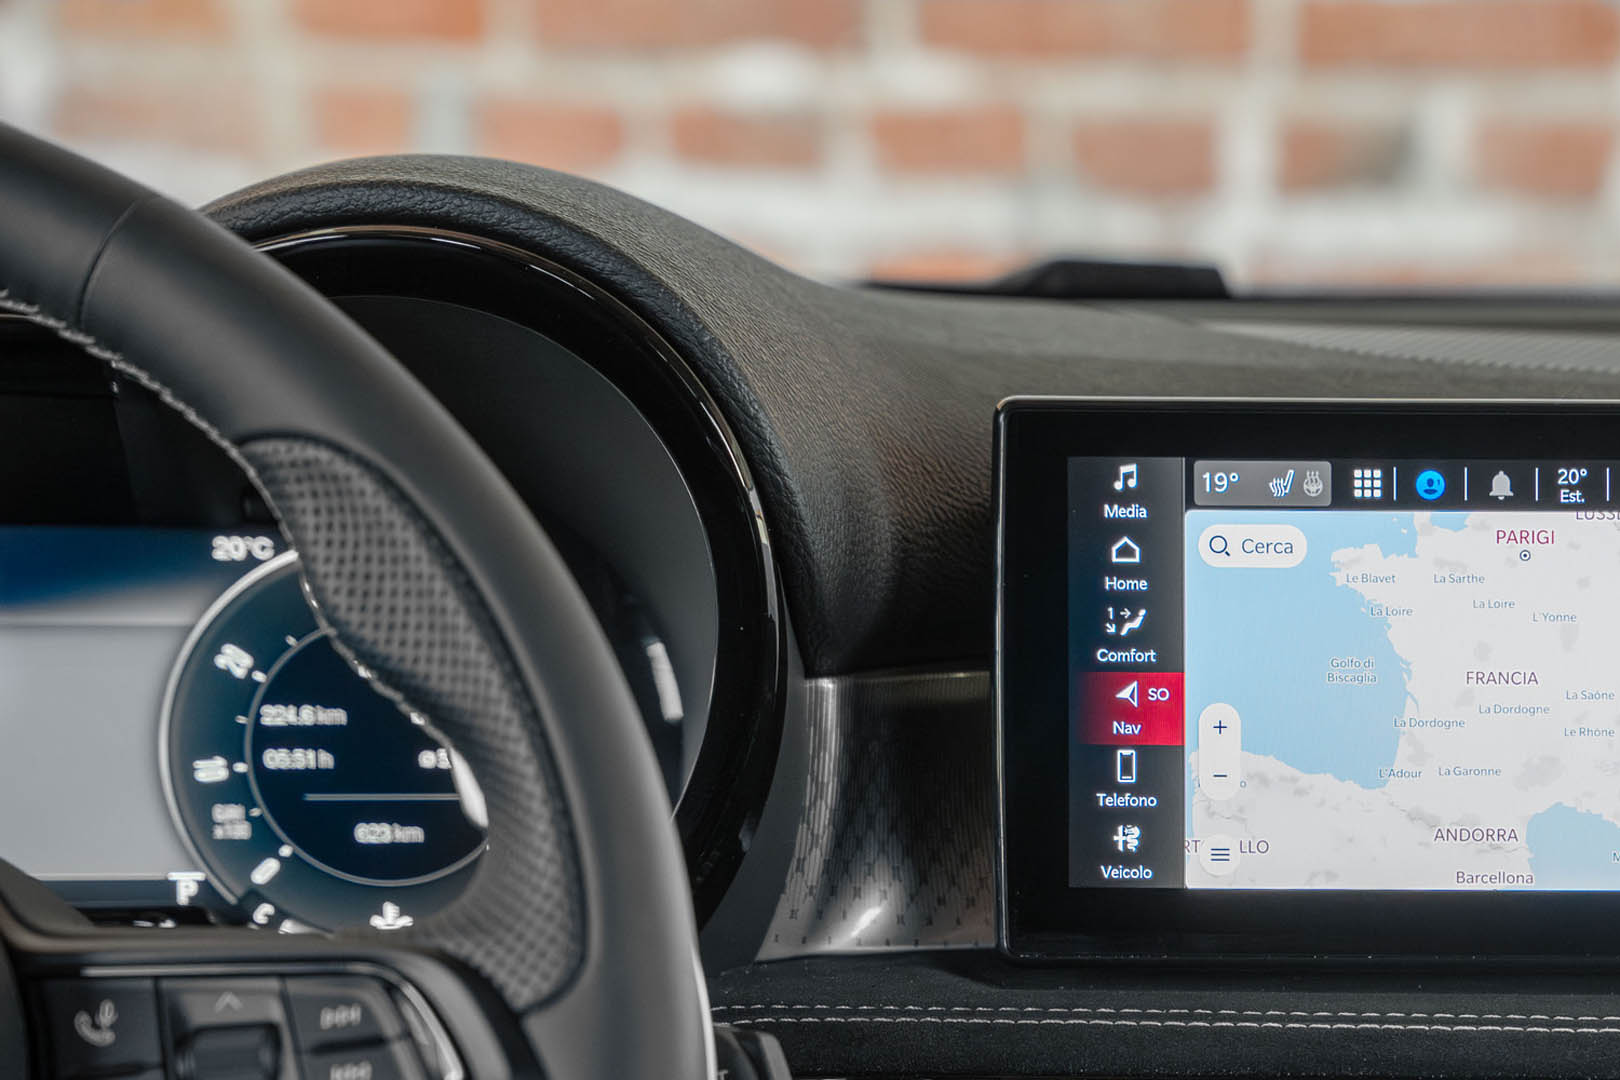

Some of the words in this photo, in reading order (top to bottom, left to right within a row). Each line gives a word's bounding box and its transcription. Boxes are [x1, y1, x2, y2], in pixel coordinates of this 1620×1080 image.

[1202, 471, 1240, 494] 19°
[1557, 468, 1588, 485] 20°
[1559, 489, 1585, 504] Est.
[1103, 504, 1147, 519] Media
[1495, 529, 1555, 545] PARIGI
[1241, 538, 1294, 555] Cerca
[1105, 577, 1148, 592] Home
[1359, 573, 1396, 584] Blavet
[1447, 573, 1485, 584] Sarthe
[1384, 607, 1413, 617] Loire
[1097, 647, 1156, 663] Comfort
[1330, 658, 1357, 669] Golfo
[1360, 658, 1375, 669] di
[1327, 671, 1377, 685] Biscaglia
[1466, 671, 1539, 686] FRANCIA
[1147, 687, 1170, 701] SO
[1493, 704, 1550, 716] Dordogne
[1112, 720, 1142, 735] Nav
[1408, 718, 1466, 730] Dordogne
[1451, 766, 1502, 777] Garonne
[1096, 793, 1158, 808] Telefono
[1434, 828, 1519, 842] ANDORRA
[1100, 865, 1153, 880] Veicolo
[1455, 870, 1534, 885] Barcellona
